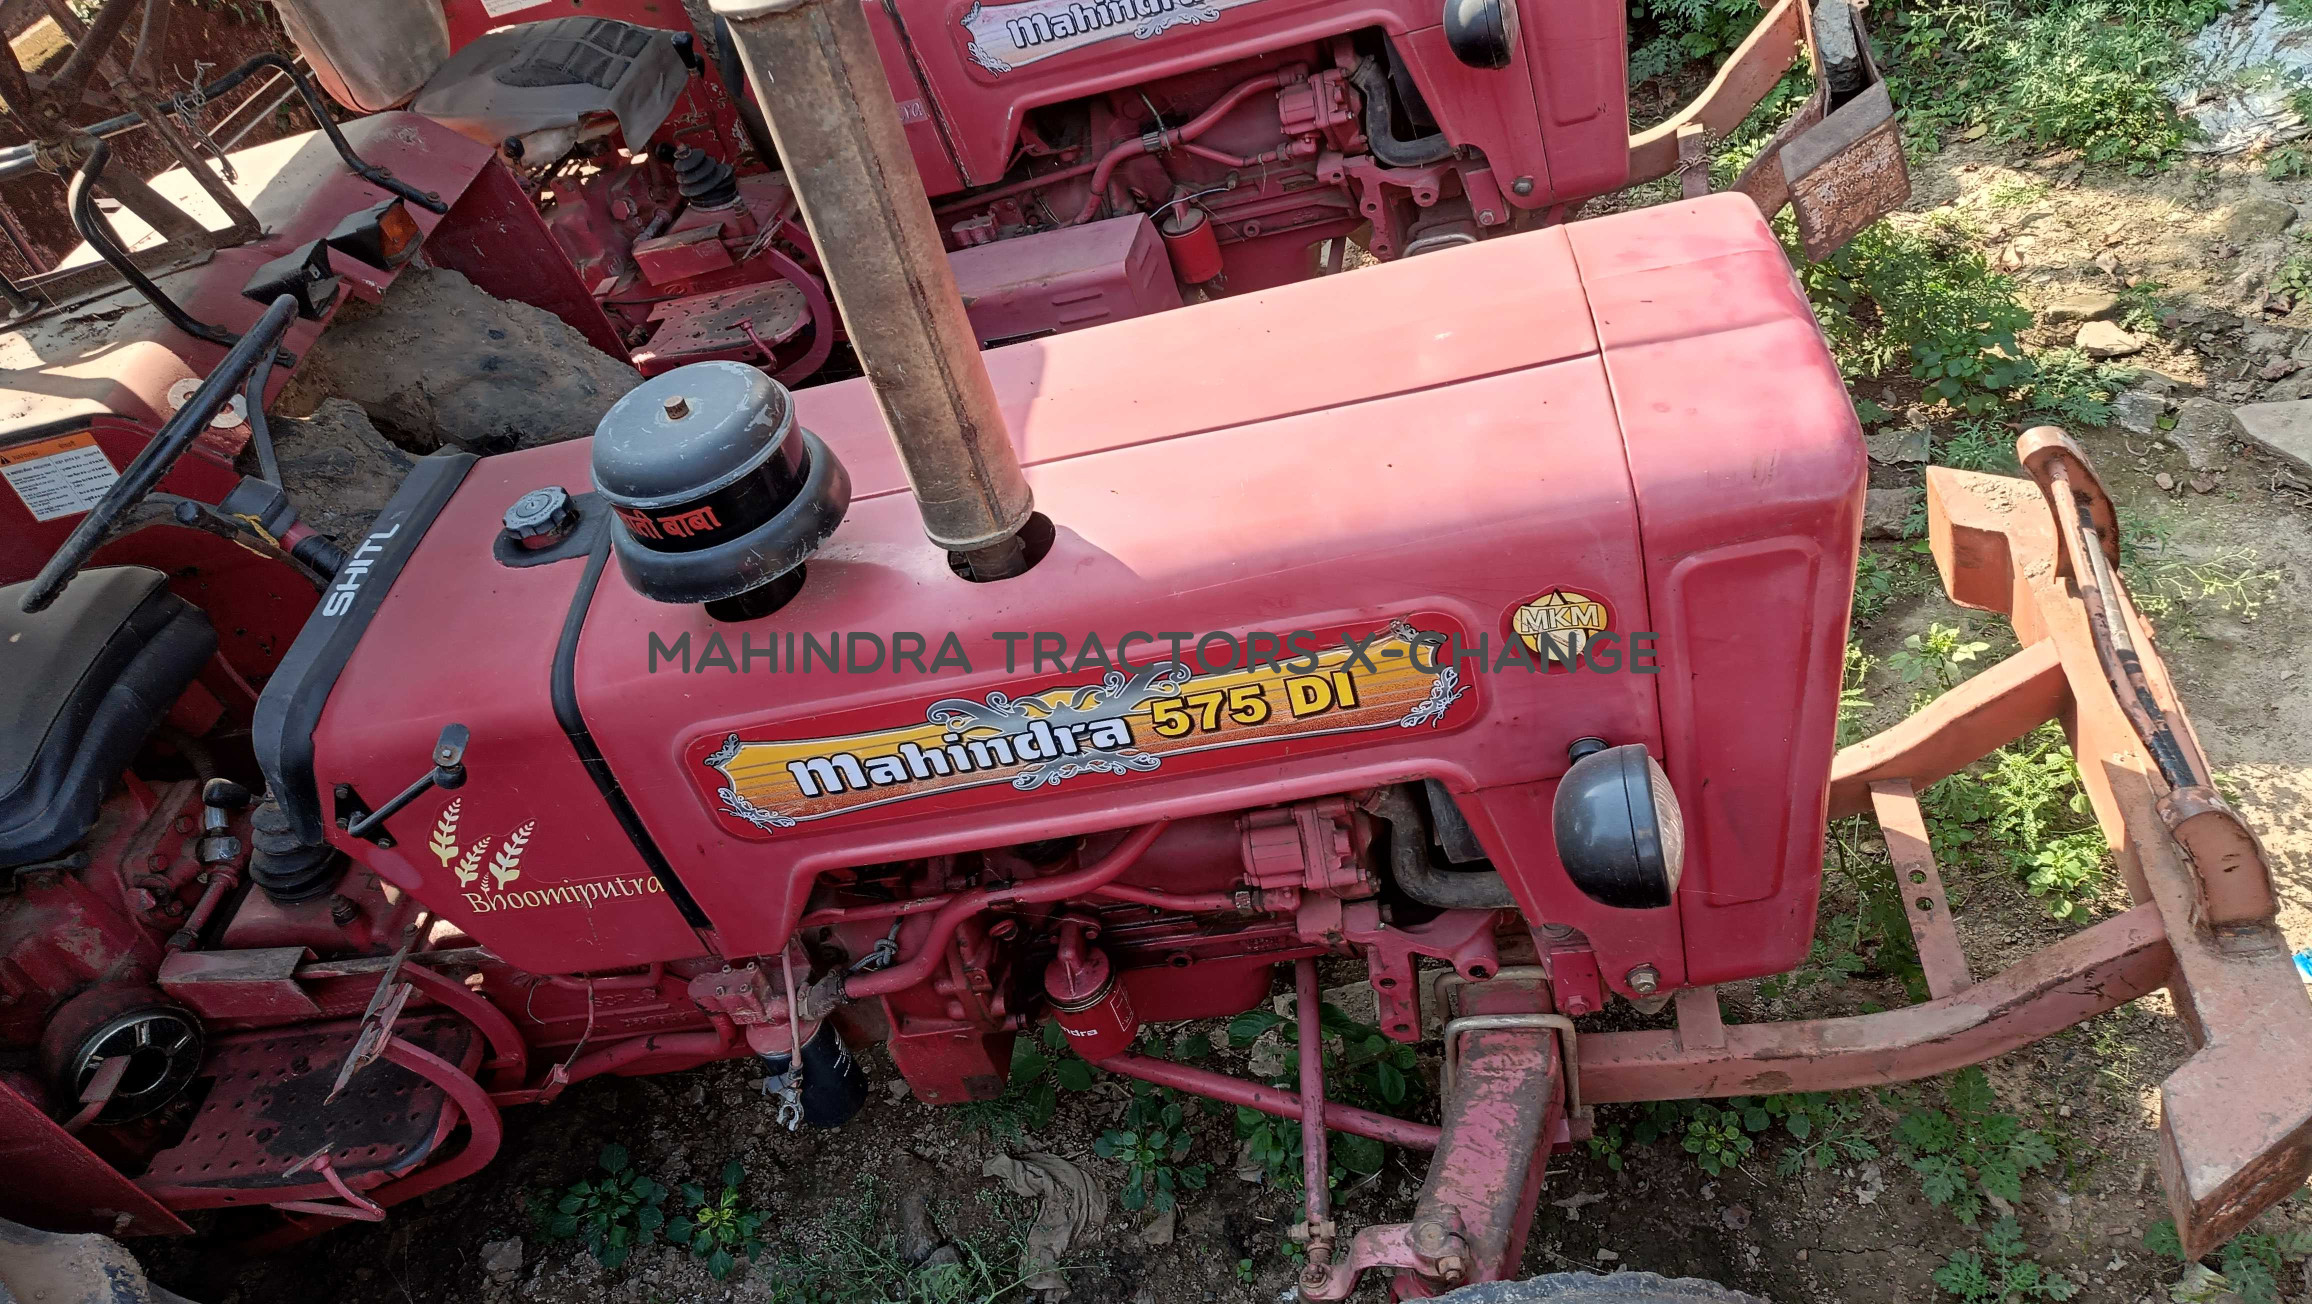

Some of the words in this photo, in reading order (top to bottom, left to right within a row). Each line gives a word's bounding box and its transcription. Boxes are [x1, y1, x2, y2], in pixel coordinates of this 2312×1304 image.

[657, 506, 722, 538] बाबा
[322, 523, 400, 617] SHITL
[1520, 604, 1600, 633] MKM
[786, 715, 1133, 798] Mahindra
[1151, 683, 1272, 737] 575
[1284, 670, 1360, 718] DI
[461, 875, 665, 913] Bhoomiputra
